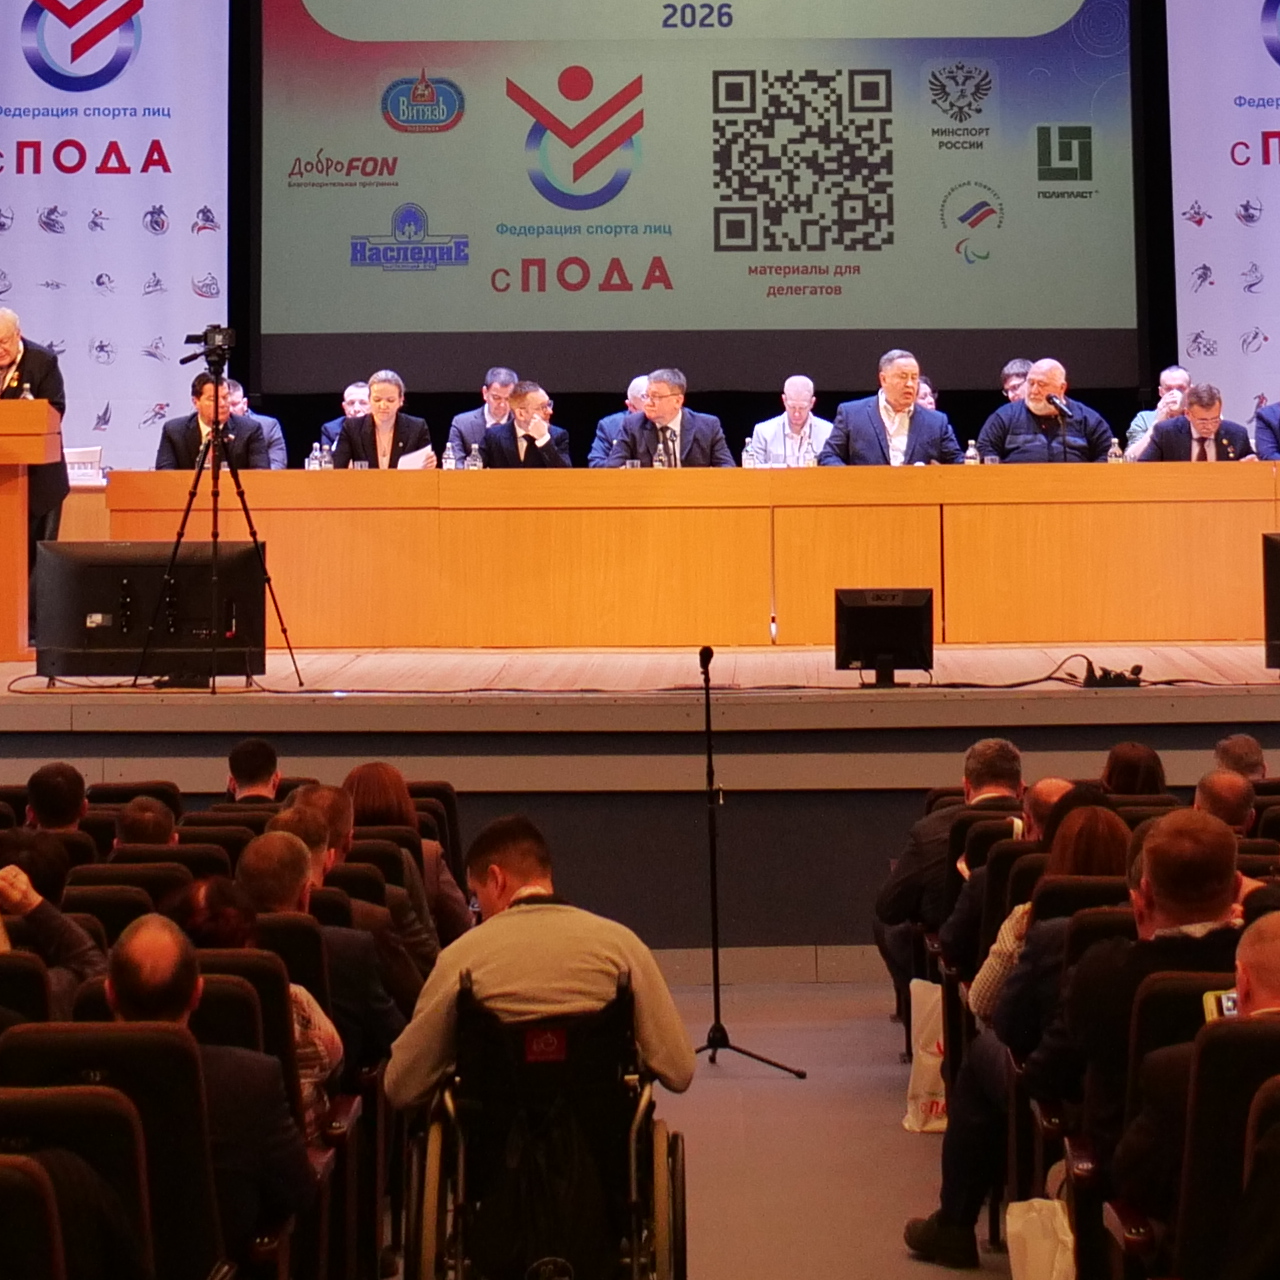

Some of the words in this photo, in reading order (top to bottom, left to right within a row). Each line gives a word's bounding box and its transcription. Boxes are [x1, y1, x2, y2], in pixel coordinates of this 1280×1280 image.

[661, 3, 733, 29] 2026
[83, 105, 137, 119] спорта
[142, 106, 171, 119] лиц
[931, 127, 990, 137] МИНСПОРТ
[938, 141, 984, 150] РОССИИ
[1037, 191, 1094, 199] ПОЛИПЛАСТ
[496, 223, 582, 237] Федерация
[586, 223, 639, 237] спорта
[643, 223, 672, 237] лиц
[748, 264, 830, 277] материалы
[833, 264, 861, 277] для
[767, 284, 842, 298] делегатов
